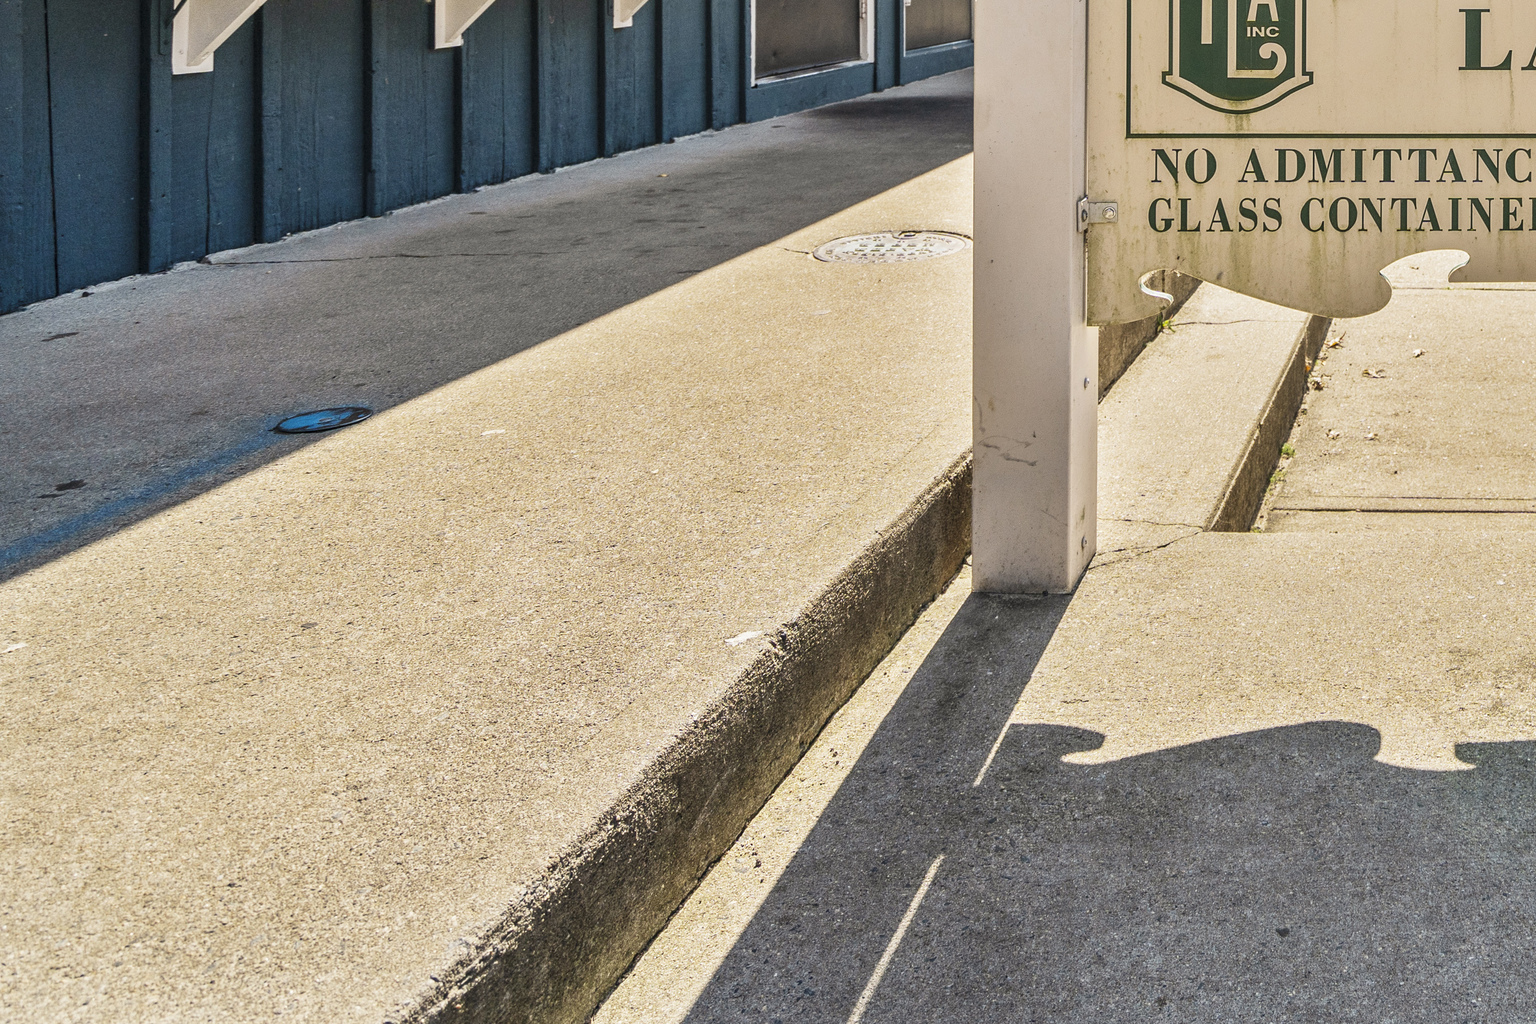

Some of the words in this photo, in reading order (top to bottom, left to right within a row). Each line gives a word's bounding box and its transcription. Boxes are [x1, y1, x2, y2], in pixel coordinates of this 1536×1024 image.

[1246, 25, 1279, 37] INC
[1151, 148, 1217, 184] NO
[1148, 197, 1282, 233] GLASS
